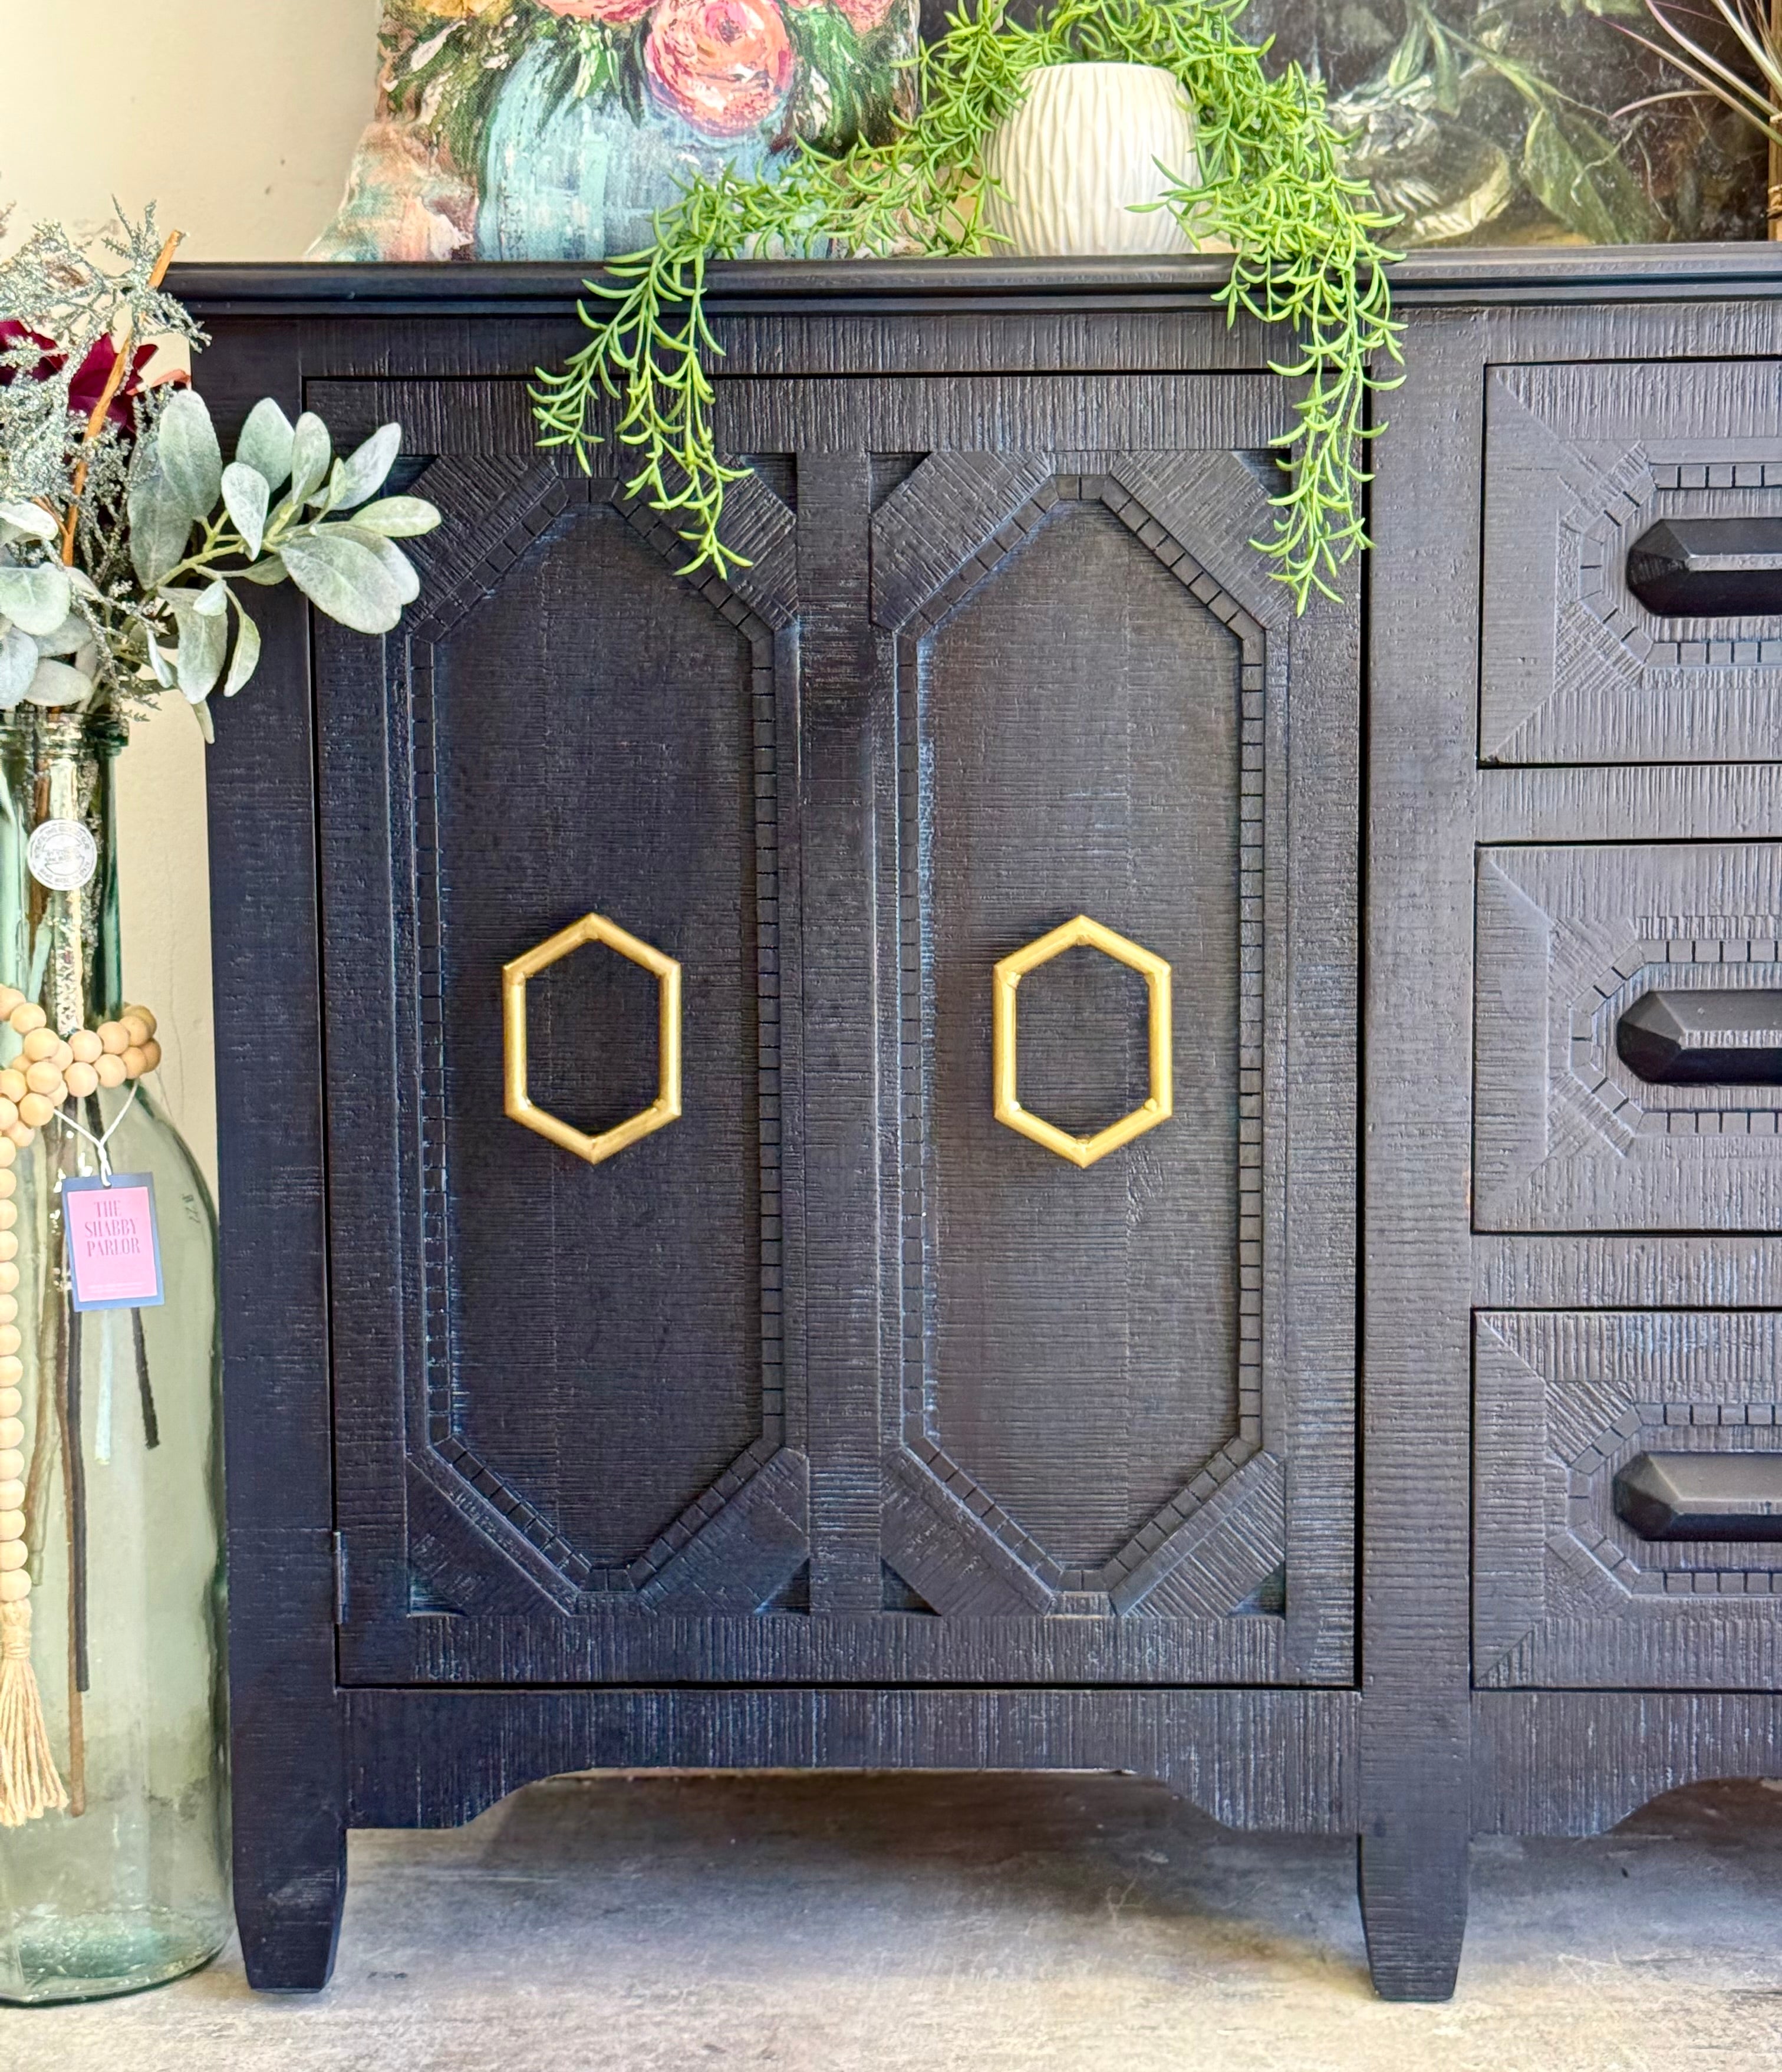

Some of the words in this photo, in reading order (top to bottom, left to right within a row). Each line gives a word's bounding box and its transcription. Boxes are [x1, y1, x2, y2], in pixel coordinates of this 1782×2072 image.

[94, 1200, 121, 1217] THE
[84, 1218, 138, 1238] SHABBY
[87, 1238, 140, 1257] PARLOR
